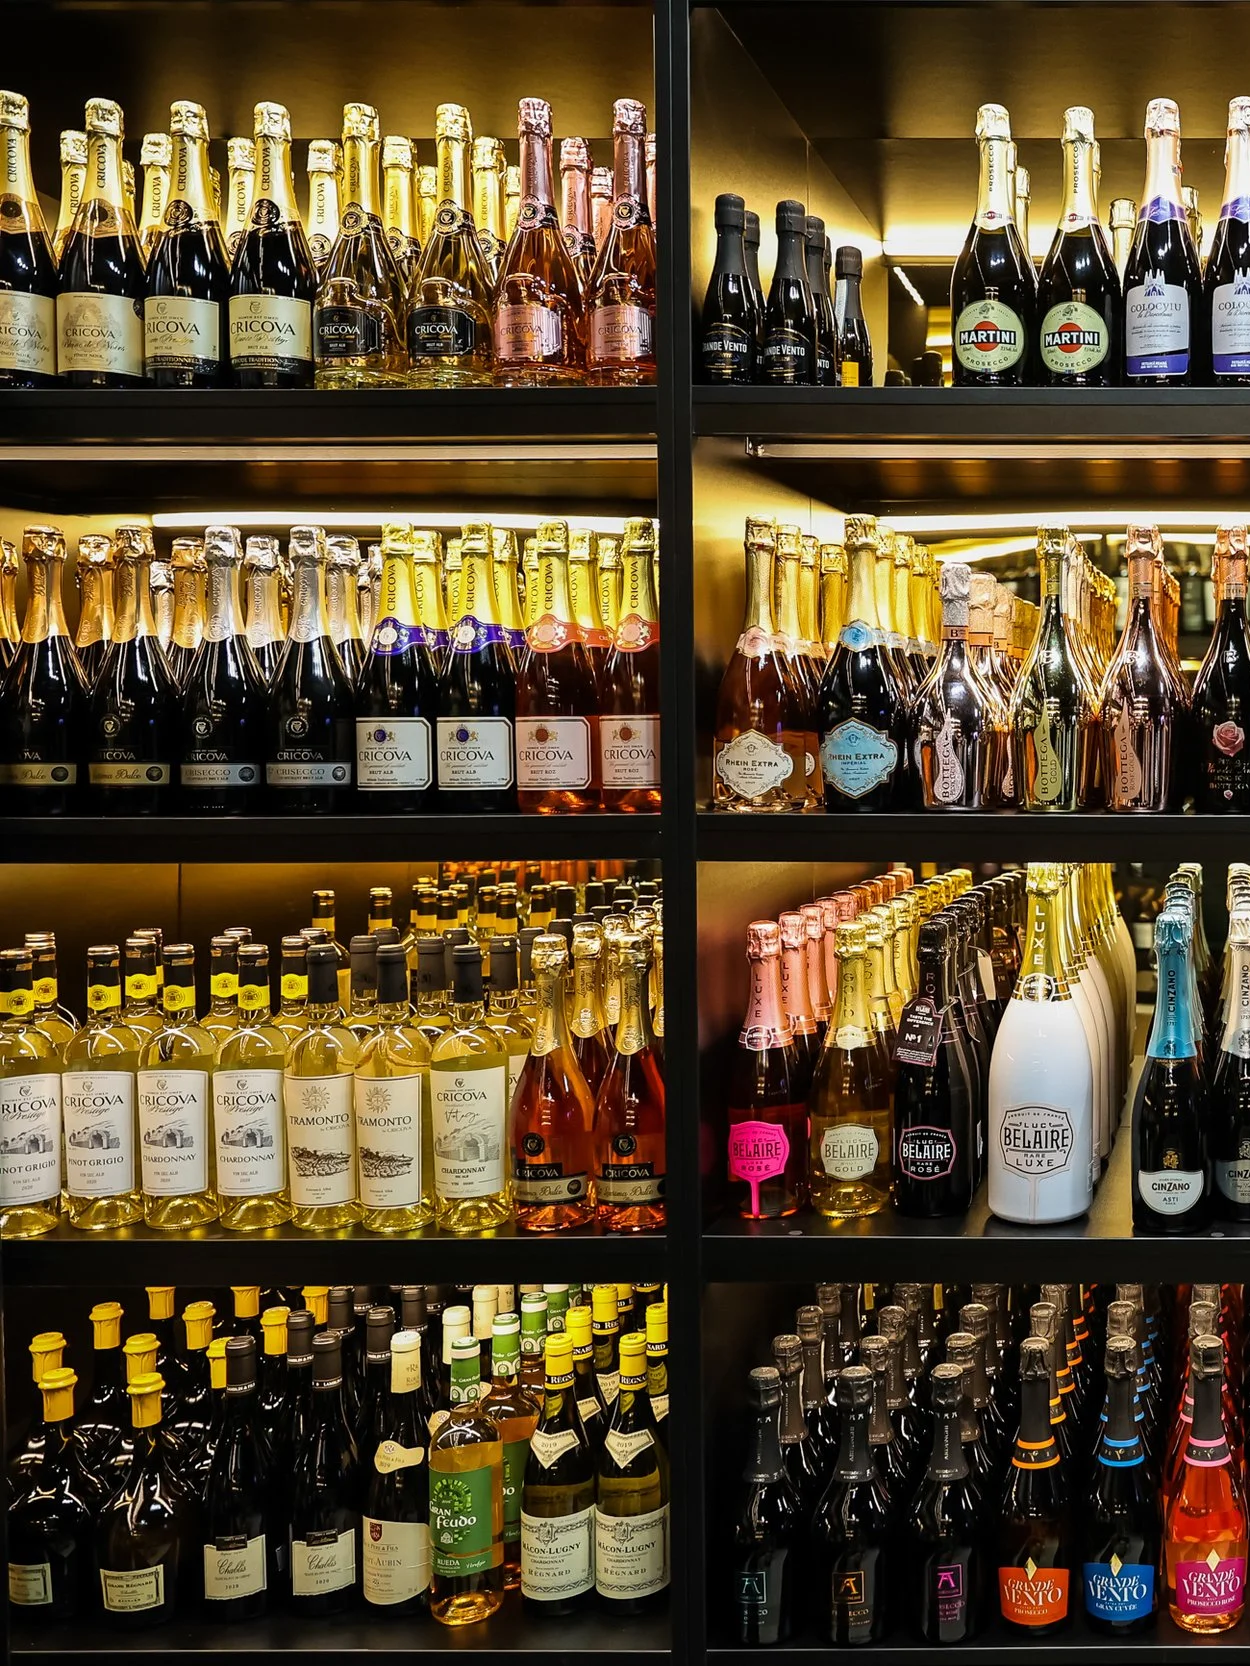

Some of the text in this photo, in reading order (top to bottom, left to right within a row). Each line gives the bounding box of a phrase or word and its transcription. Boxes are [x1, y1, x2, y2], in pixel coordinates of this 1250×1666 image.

[8, 138, 18, 183] CRICOVA
[97, 143, 107, 188] CRICOVA
[177, 147, 187, 191] CRICOVA
[261, 147, 270, 191] CRICOVA
[70, 173, 80, 215] CRICOVA
[66, 328, 116, 340] CRICOVA
[230, 322, 296, 335] CRICOVA
[319, 325, 360, 336] CRICOVA
[415, 324, 458, 335] CRICOVA
[599, 325, 643, 336] CRICOVA
[960, 330, 1015, 344] MARTINI
[1045, 329, 1098, 345] MARTINI
[724, 341, 747, 352] VENTO
[781, 345, 805, 356] VENTO
[966, 356, 1009, 368] PROSECCO
[1051, 356, 1092, 367] PROSECCO
[388, 564, 396, 611] CRICOVA
[277, 751, 323, 760] CRICOVA
[359, 750, 412, 761] CRICOVA
[441, 750, 494, 761] CRICOVA
[605, 750, 656, 760] CRICOVA
[855, 753, 885, 761] EXTRA
[726, 759, 748, 767] RHEIN
[1040, 736, 1048, 794] BOTTEGA
[276, 768, 325, 776] CRISECCO
[1034, 905, 1045, 965] LUXE
[1168, 969, 1176, 1013] CINZANO
[1241, 964, 1249, 1007] CINZANO
[754, 973, 763, 1019] LUXE
[843, 972, 855, 1019] GOLD
[65, 1095, 124, 1107] CRICOVA
[140, 1094, 197, 1105] CRICOVA
[217, 1093, 276, 1105] CRICOVA
[437, 1092, 487, 1101] CRICOVA
[290, 1112, 349, 1125] TRAMONTO
[358, 1116, 412, 1127] TRAMONTO
[1004, 1127, 1069, 1150] BELAIRE
[733, 1141, 781, 1157] BELAIRE
[825, 1141, 873, 1157] BELAIRE
[903, 1143, 950, 1159] BELAIRE
[68, 1156, 124, 1166] PINOT GRIGIO
[220, 1153, 275, 1163] CHARDONNAY
[442, 1166, 486, 1174] CHARDONNAY
[516, 1168, 559, 1177] CRICOVA
[605, 1168, 649, 1177] CRICOVA
[835, 1165, 864, 1173] GOLD
[910, 1165, 940, 1173] ROSÉ
[1152, 1182, 1190, 1192] CINZANO
[522, 1542, 580, 1555] MÂCON-LUGNY
[598, 1541, 656, 1553] MÂCON-LUGNY
[217, 1556, 246, 1573] Chablis
[1093, 1575, 1139, 1586] GRANDE
[1188, 1569, 1236, 1583] GRANDE
[1008, 1579, 1054, 1591] GRANDE
[1183, 1577, 1240, 1596] VENTO
[1005, 1587, 1062, 1605] VENTO
[1089, 1583, 1147, 1601] VENTO
